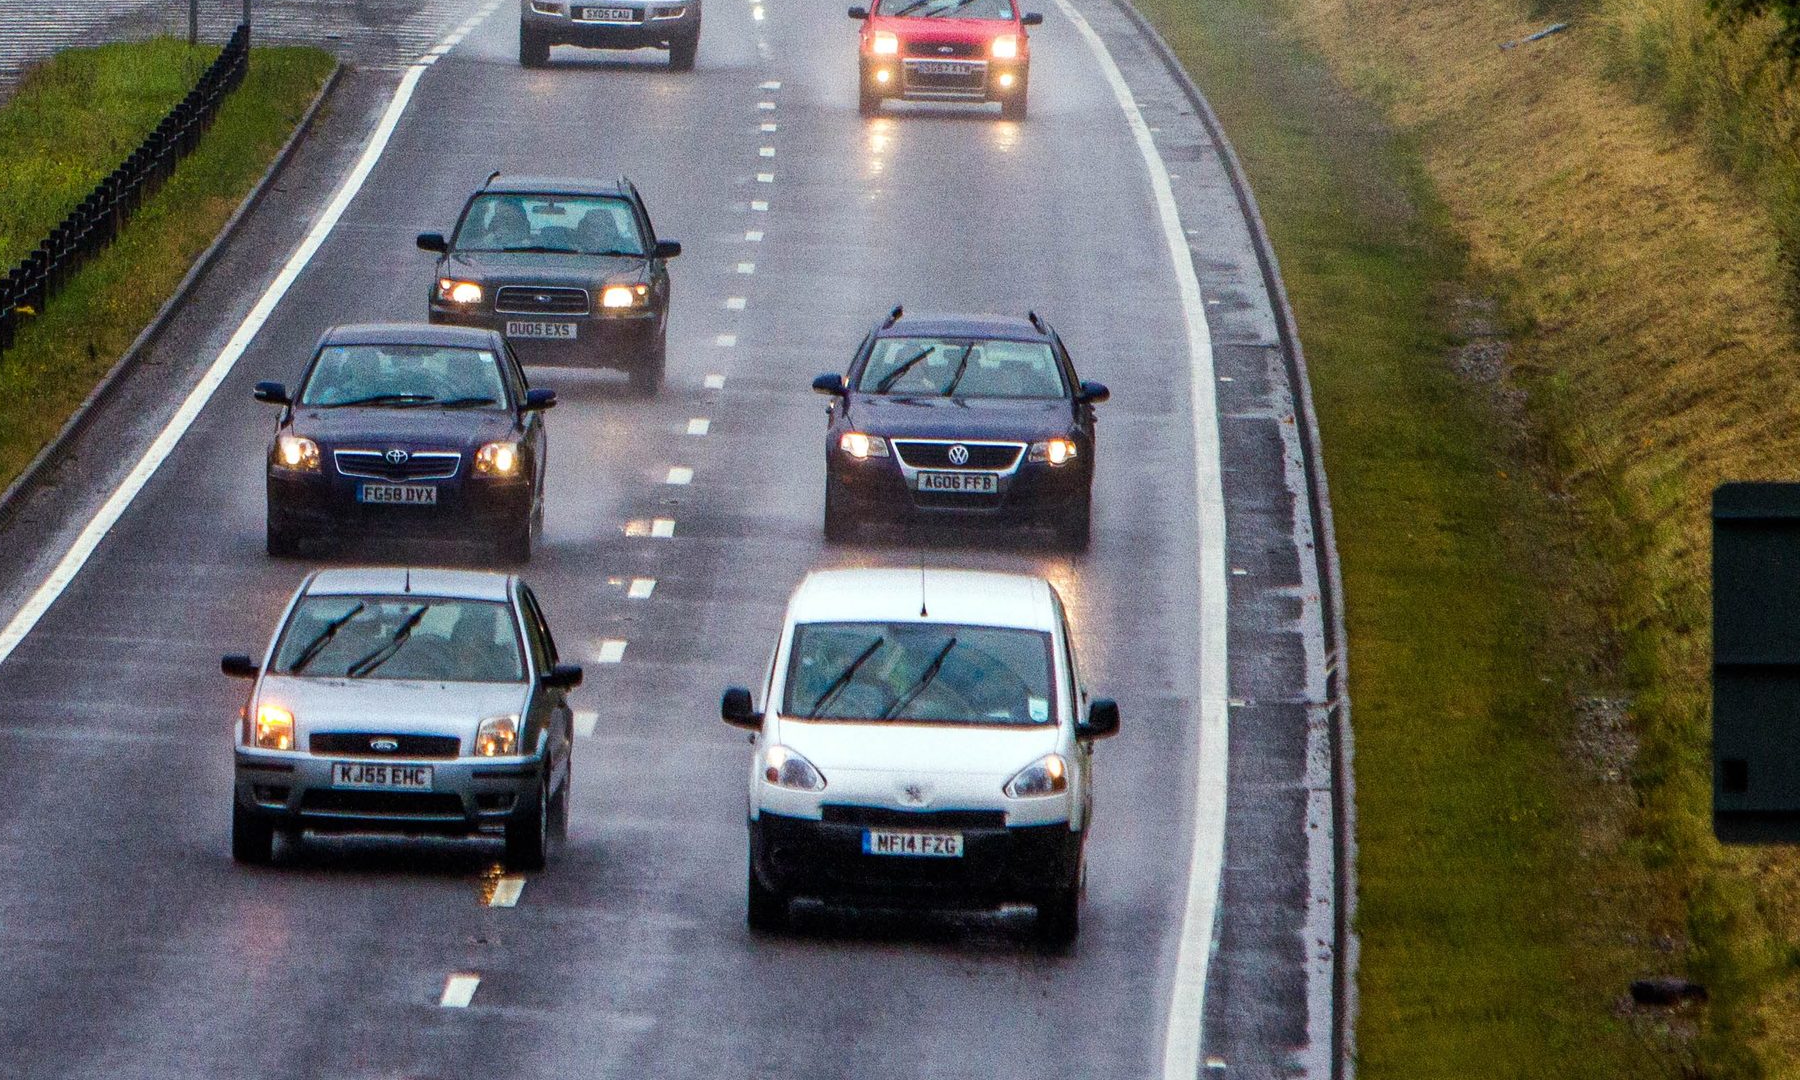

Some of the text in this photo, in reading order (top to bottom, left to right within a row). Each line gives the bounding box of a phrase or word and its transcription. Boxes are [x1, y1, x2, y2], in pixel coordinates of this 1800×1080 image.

[545, 324, 570, 336] EXS
[925, 475, 992, 490] AG06 FFB
[364, 487, 434, 502] FG58 DVX
[341, 767, 426, 785] KJ55 EHC
[878, 835, 956, 854] MF14 FZG
